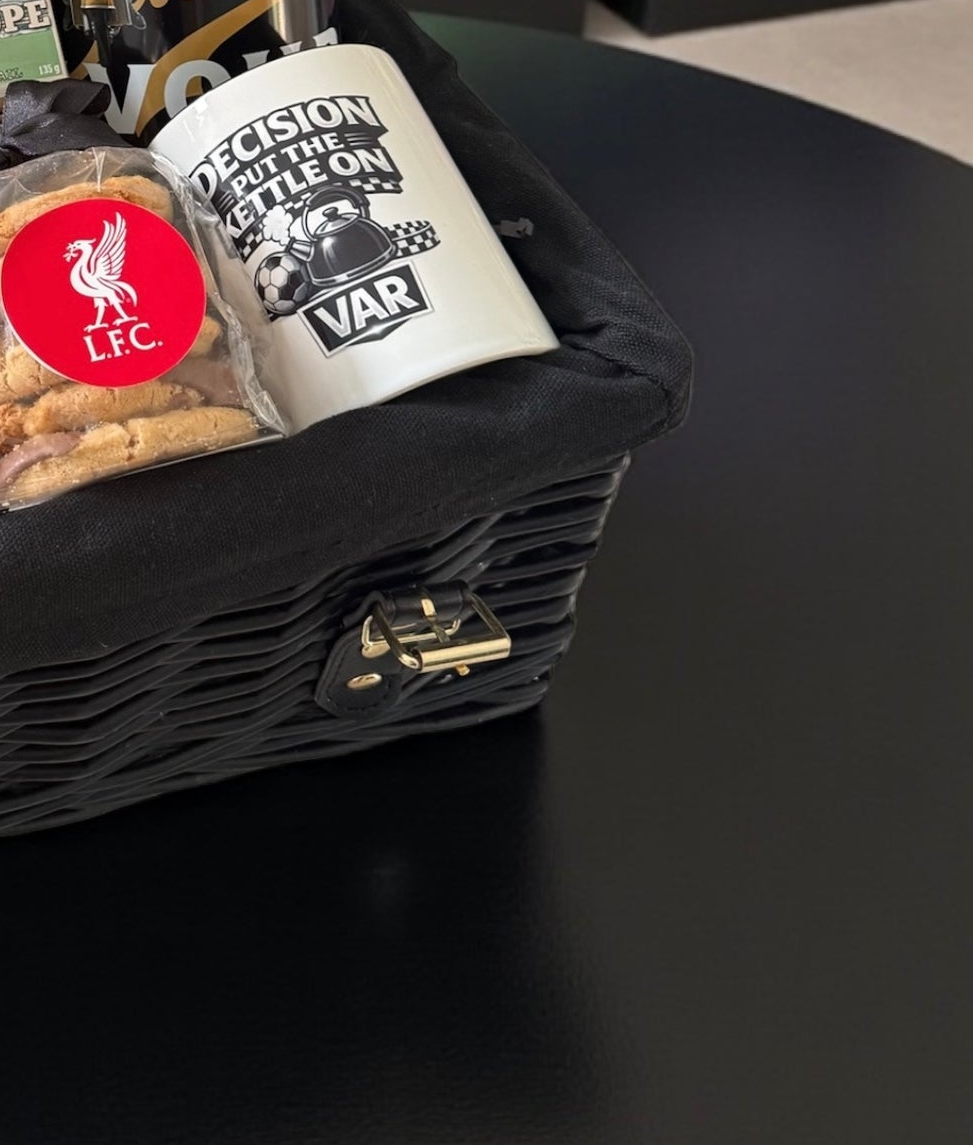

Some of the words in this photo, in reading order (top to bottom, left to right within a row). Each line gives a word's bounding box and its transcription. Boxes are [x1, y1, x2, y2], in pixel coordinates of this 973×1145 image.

[38, 65, 52, 75] 135
[190, 97, 380, 202] DECISION
[230, 154, 279, 198] PUT
[280, 132, 345, 164] THE
[226, 159, 328, 239] KETTLE
[328, 148, 395, 177] ON
[312, 275, 420, 340] VAR
[83, 322, 164, 363] L.F.C.
